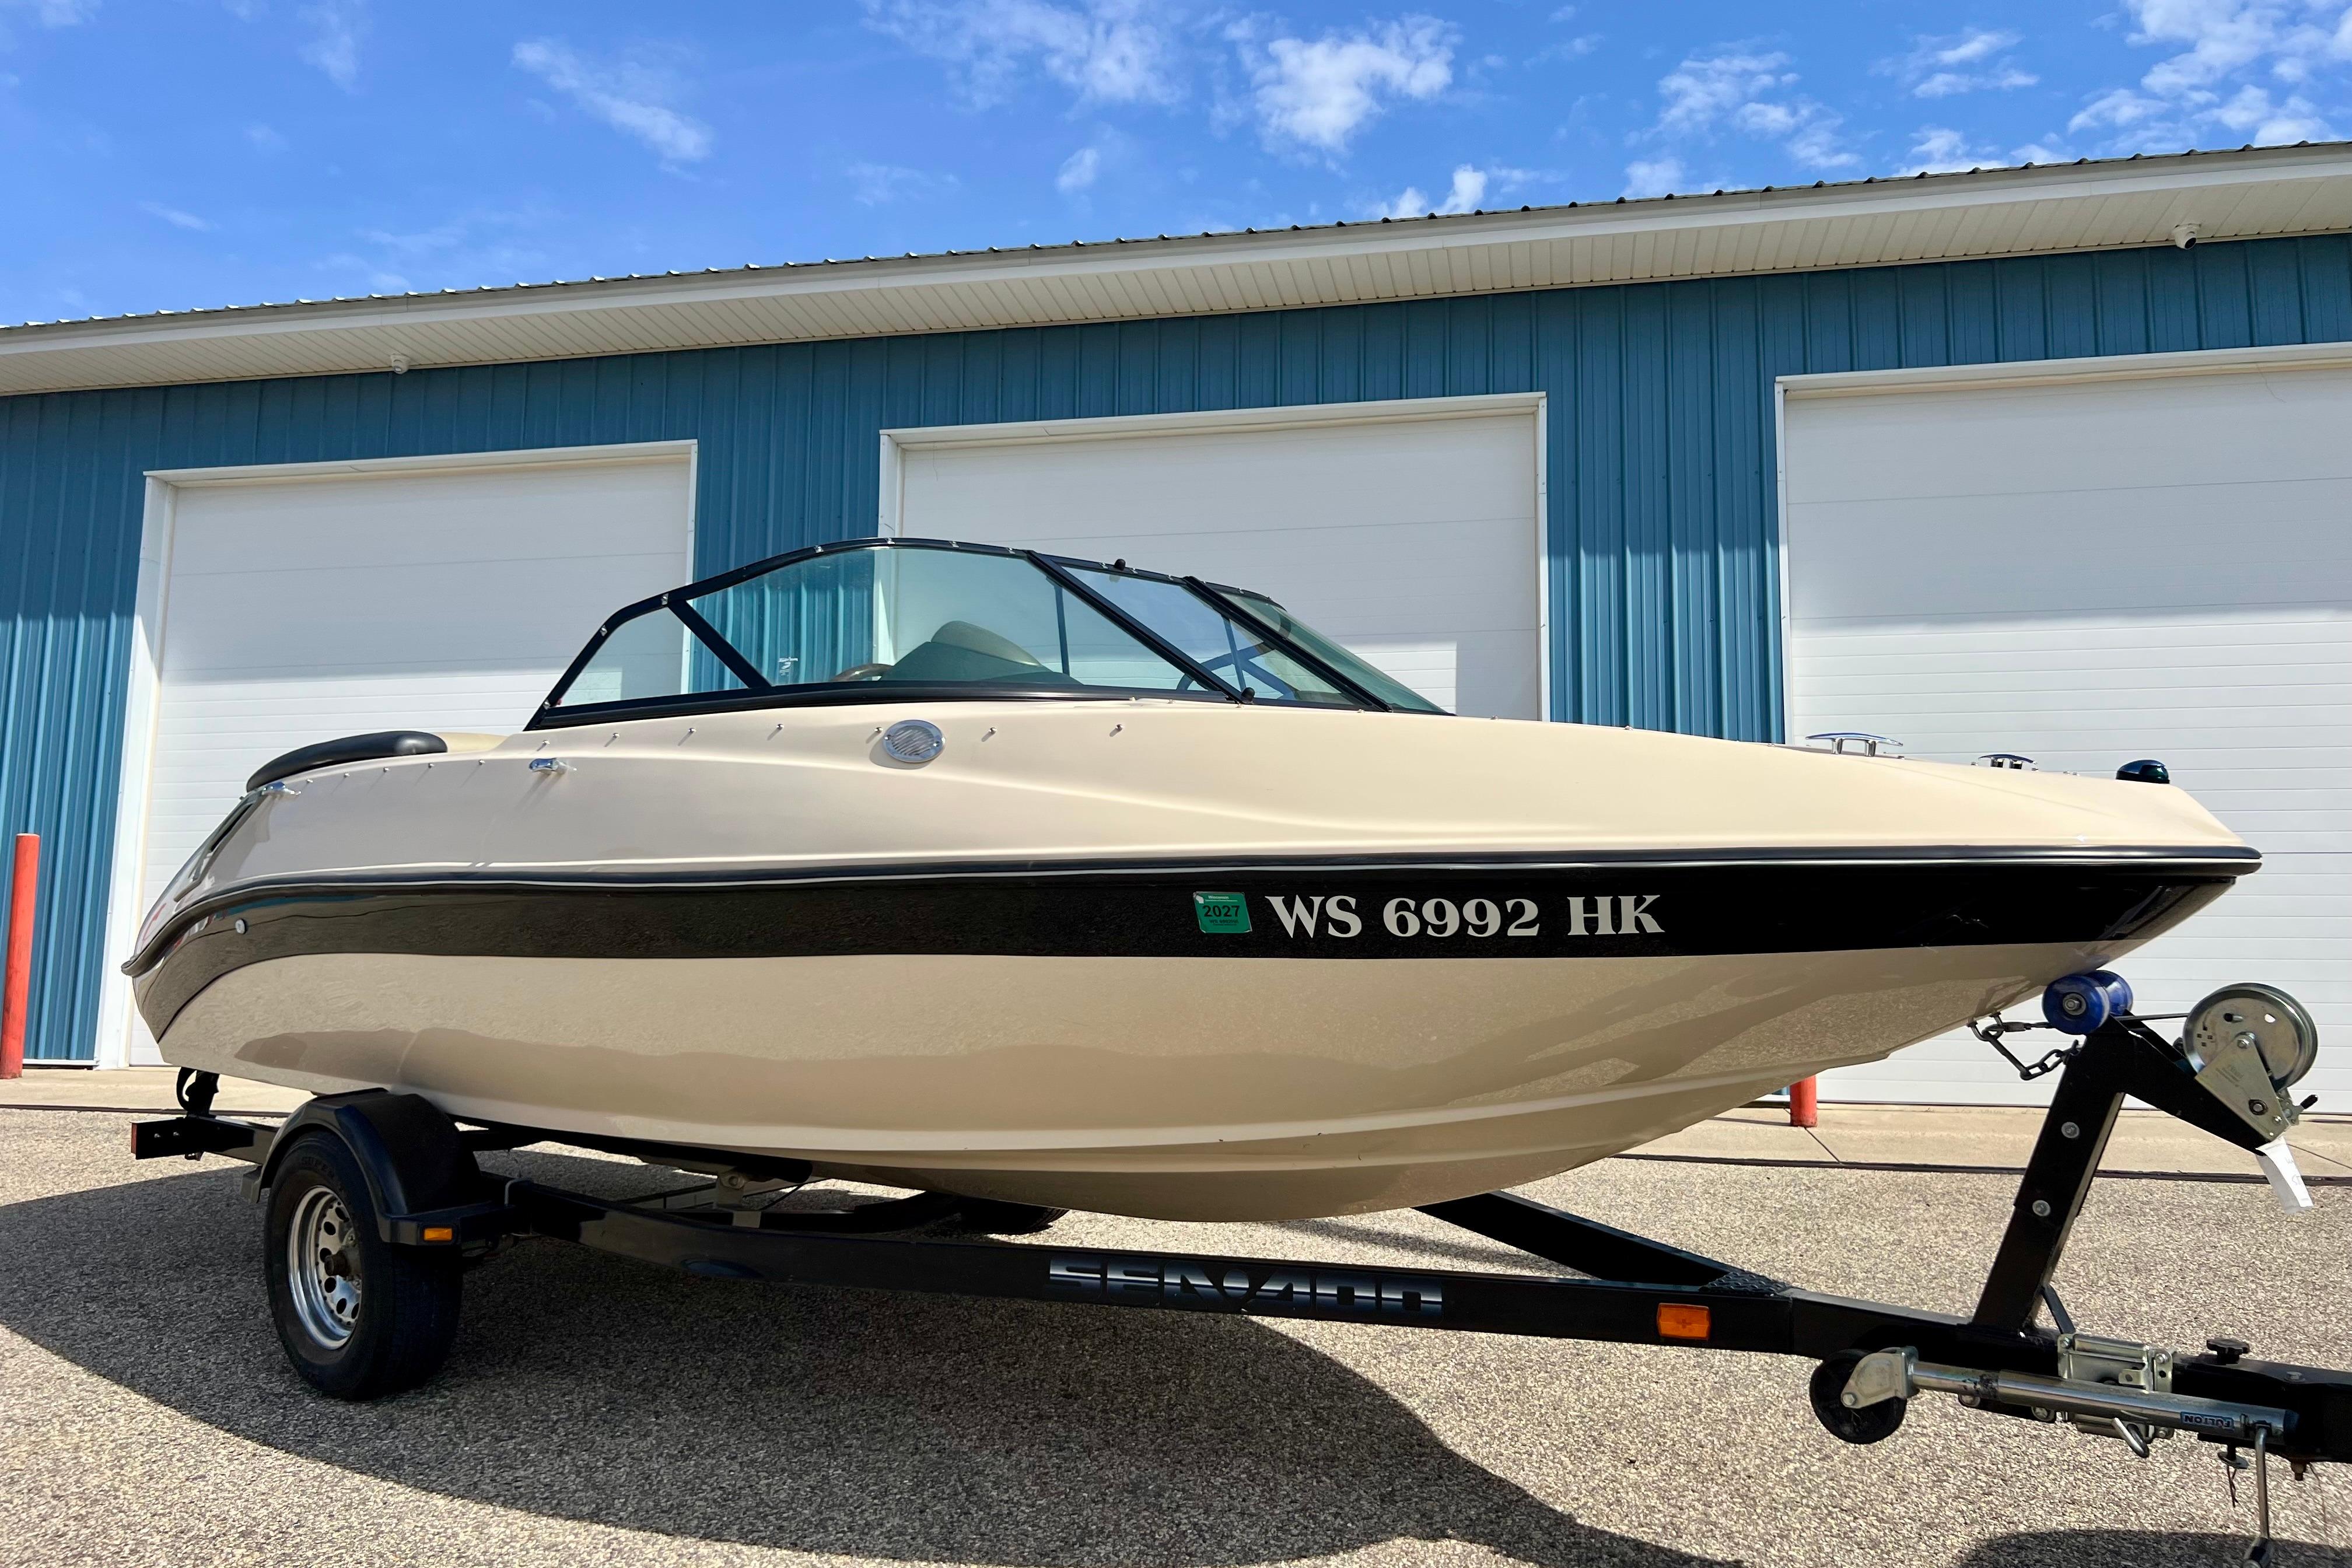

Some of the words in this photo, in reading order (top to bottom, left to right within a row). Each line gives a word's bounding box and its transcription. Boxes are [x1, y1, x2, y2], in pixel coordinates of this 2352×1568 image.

[1202, 905, 1240, 918] 2027
[1265, 894, 1363, 939] WS
[1382, 898, 1541, 937] 6992
[1566, 895, 1665, 936] HK
[2184, 1414, 2231, 1429] FULTON
